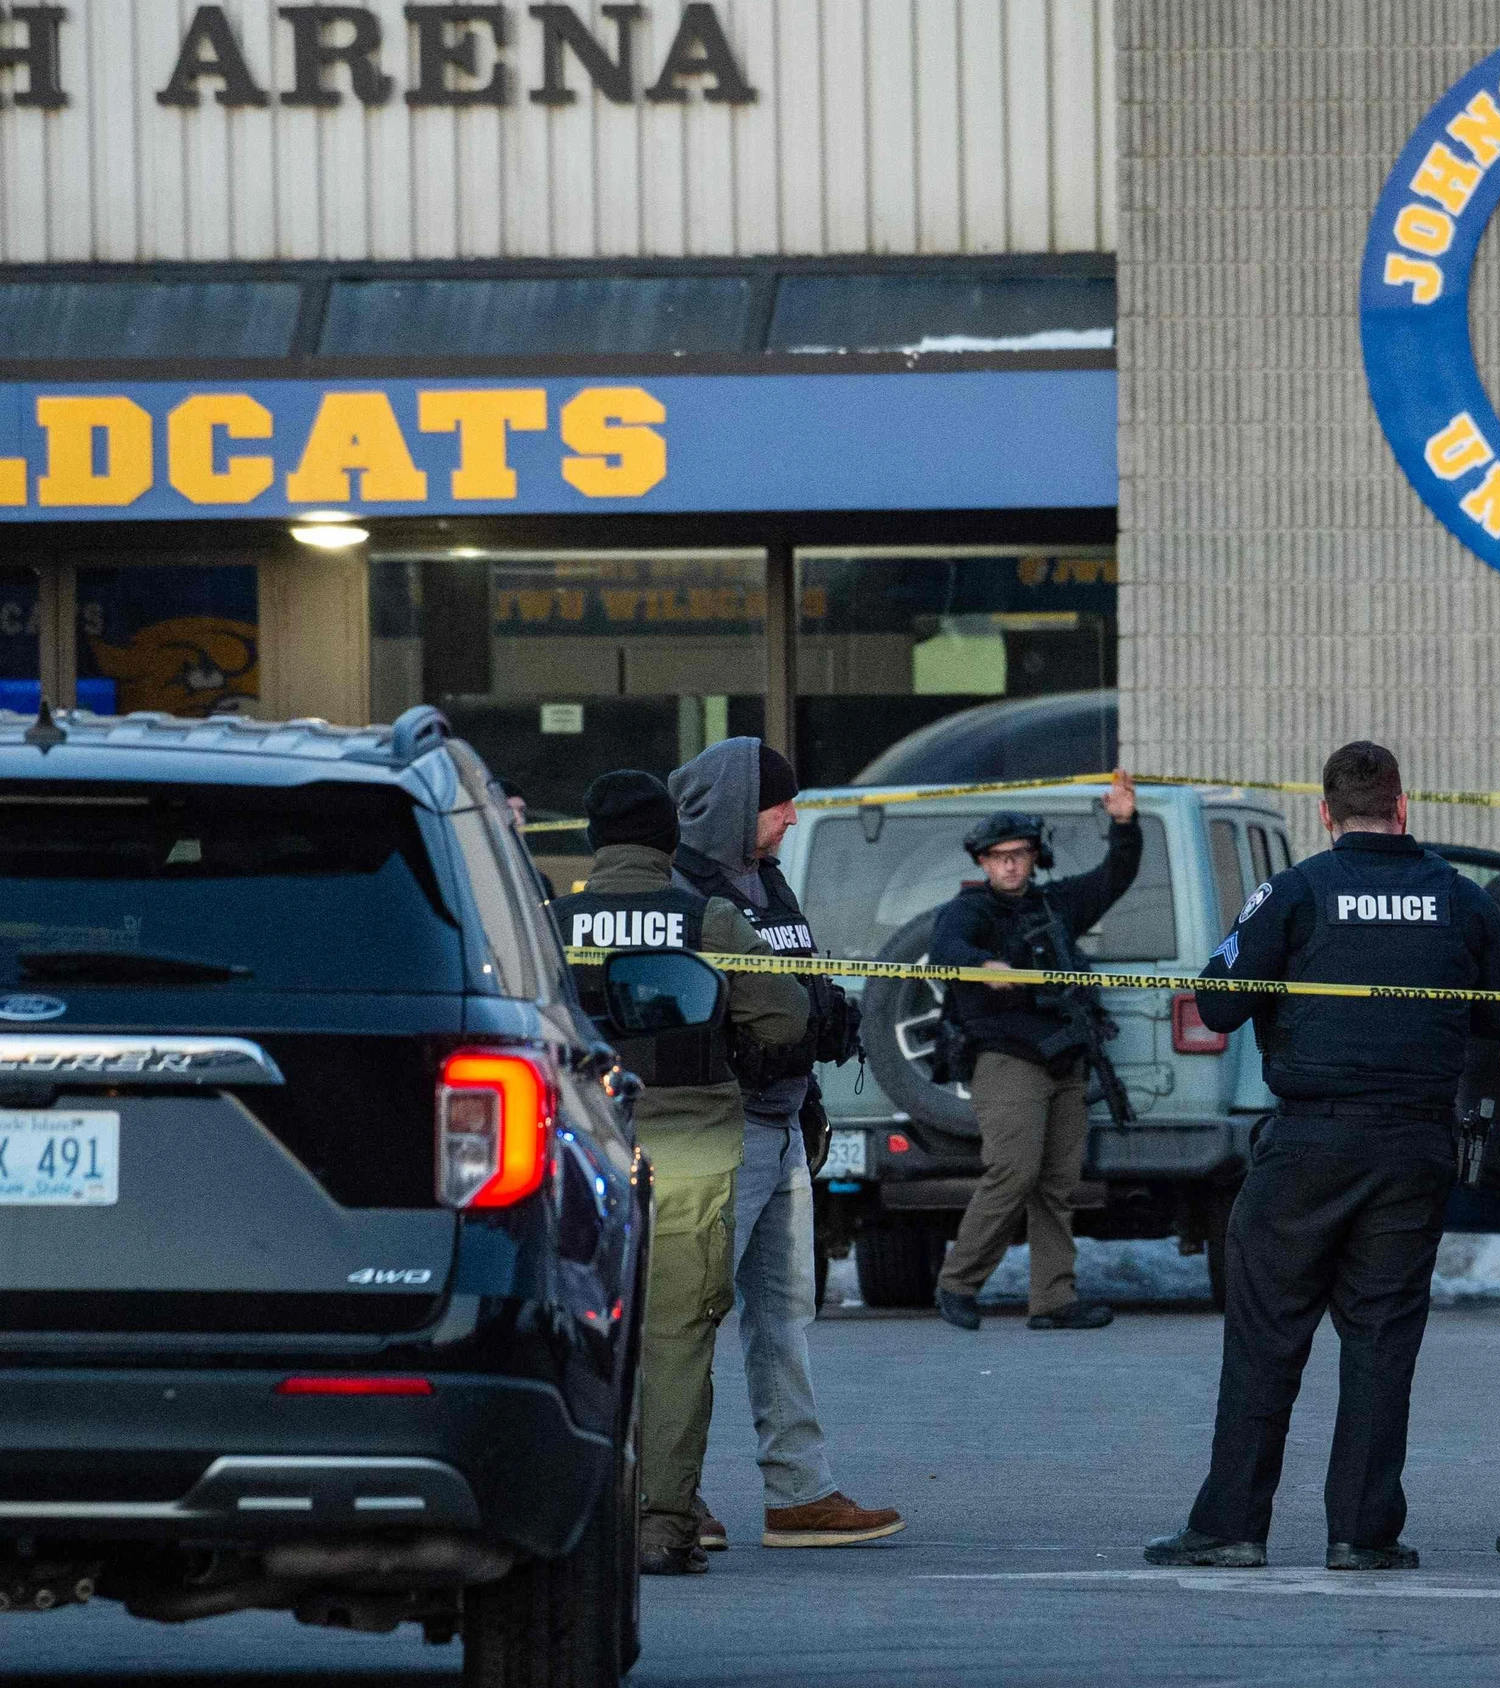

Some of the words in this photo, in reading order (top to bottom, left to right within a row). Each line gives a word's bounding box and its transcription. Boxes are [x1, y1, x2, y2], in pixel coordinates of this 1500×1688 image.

[156, 3, 759, 107] ARENA
[1337, 895, 1437, 921] POLICE
[572, 911, 684, 948] POLICE
[38, 1136, 103, 1179] 491
[347, 1268, 431, 1284] 4WD
